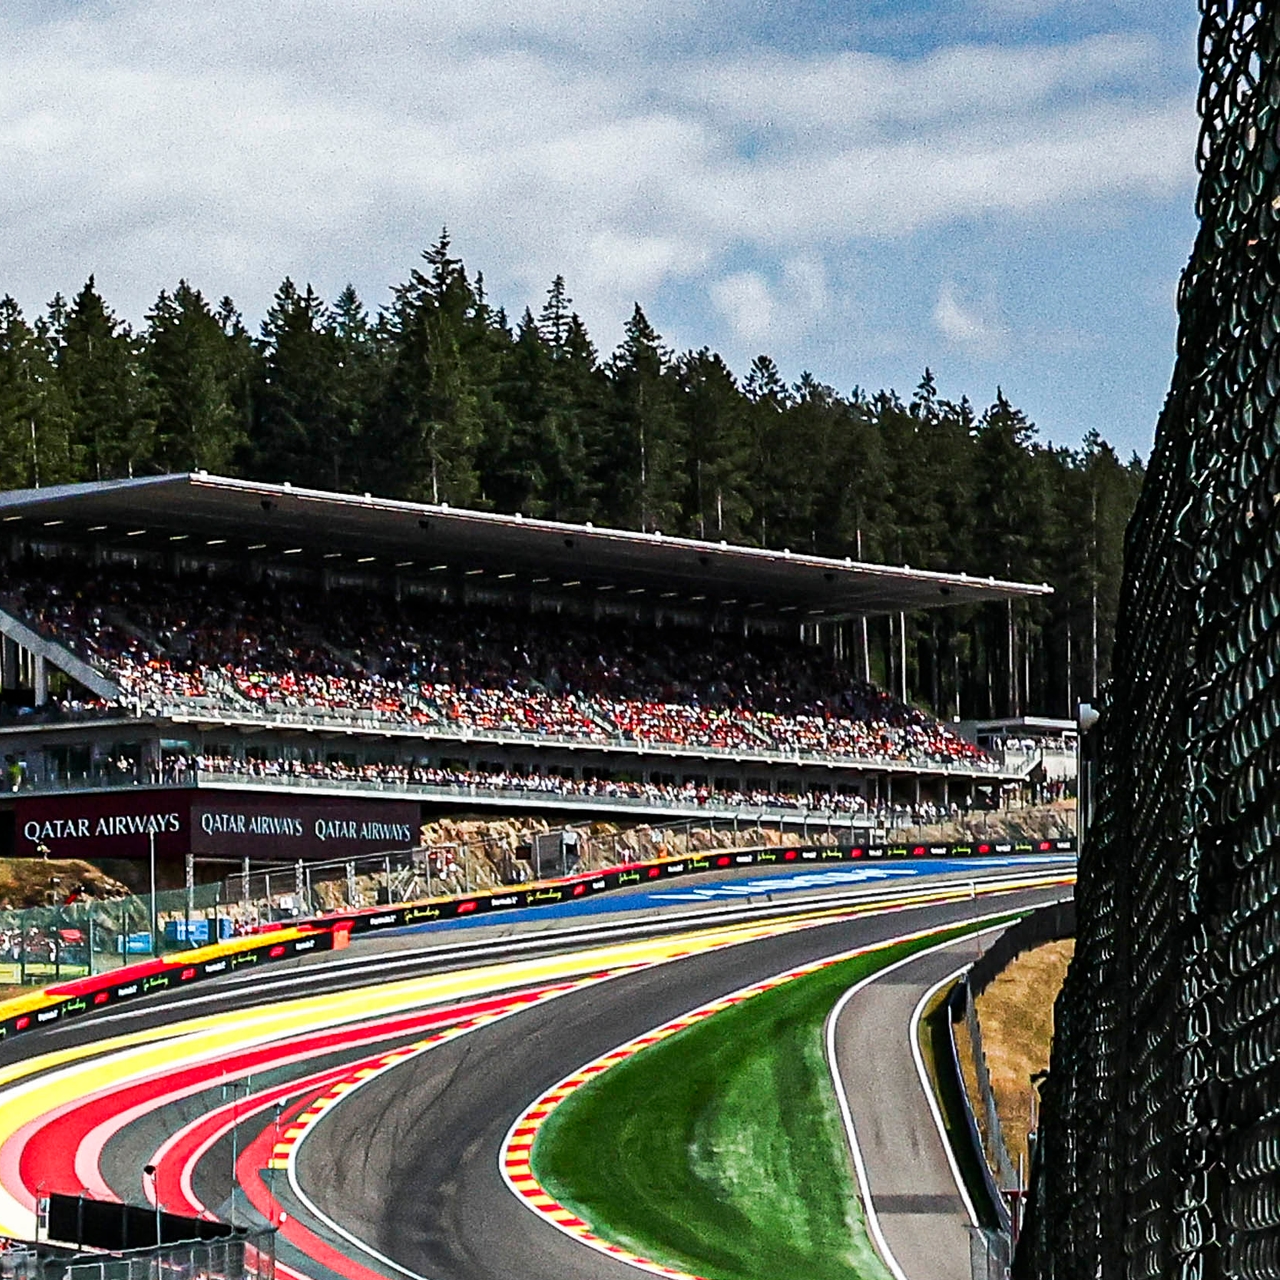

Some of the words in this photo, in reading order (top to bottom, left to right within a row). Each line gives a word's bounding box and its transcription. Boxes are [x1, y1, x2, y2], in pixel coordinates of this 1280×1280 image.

[23, 819, 90, 842] QATAR
[96, 813, 180, 837] AIRWAYS
[201, 813, 245, 834] QATAR
[249, 815, 304, 837] AIRWAYS
[314, 818, 357, 840] QATAR
[360, 822, 412, 842] AIRWAYS
